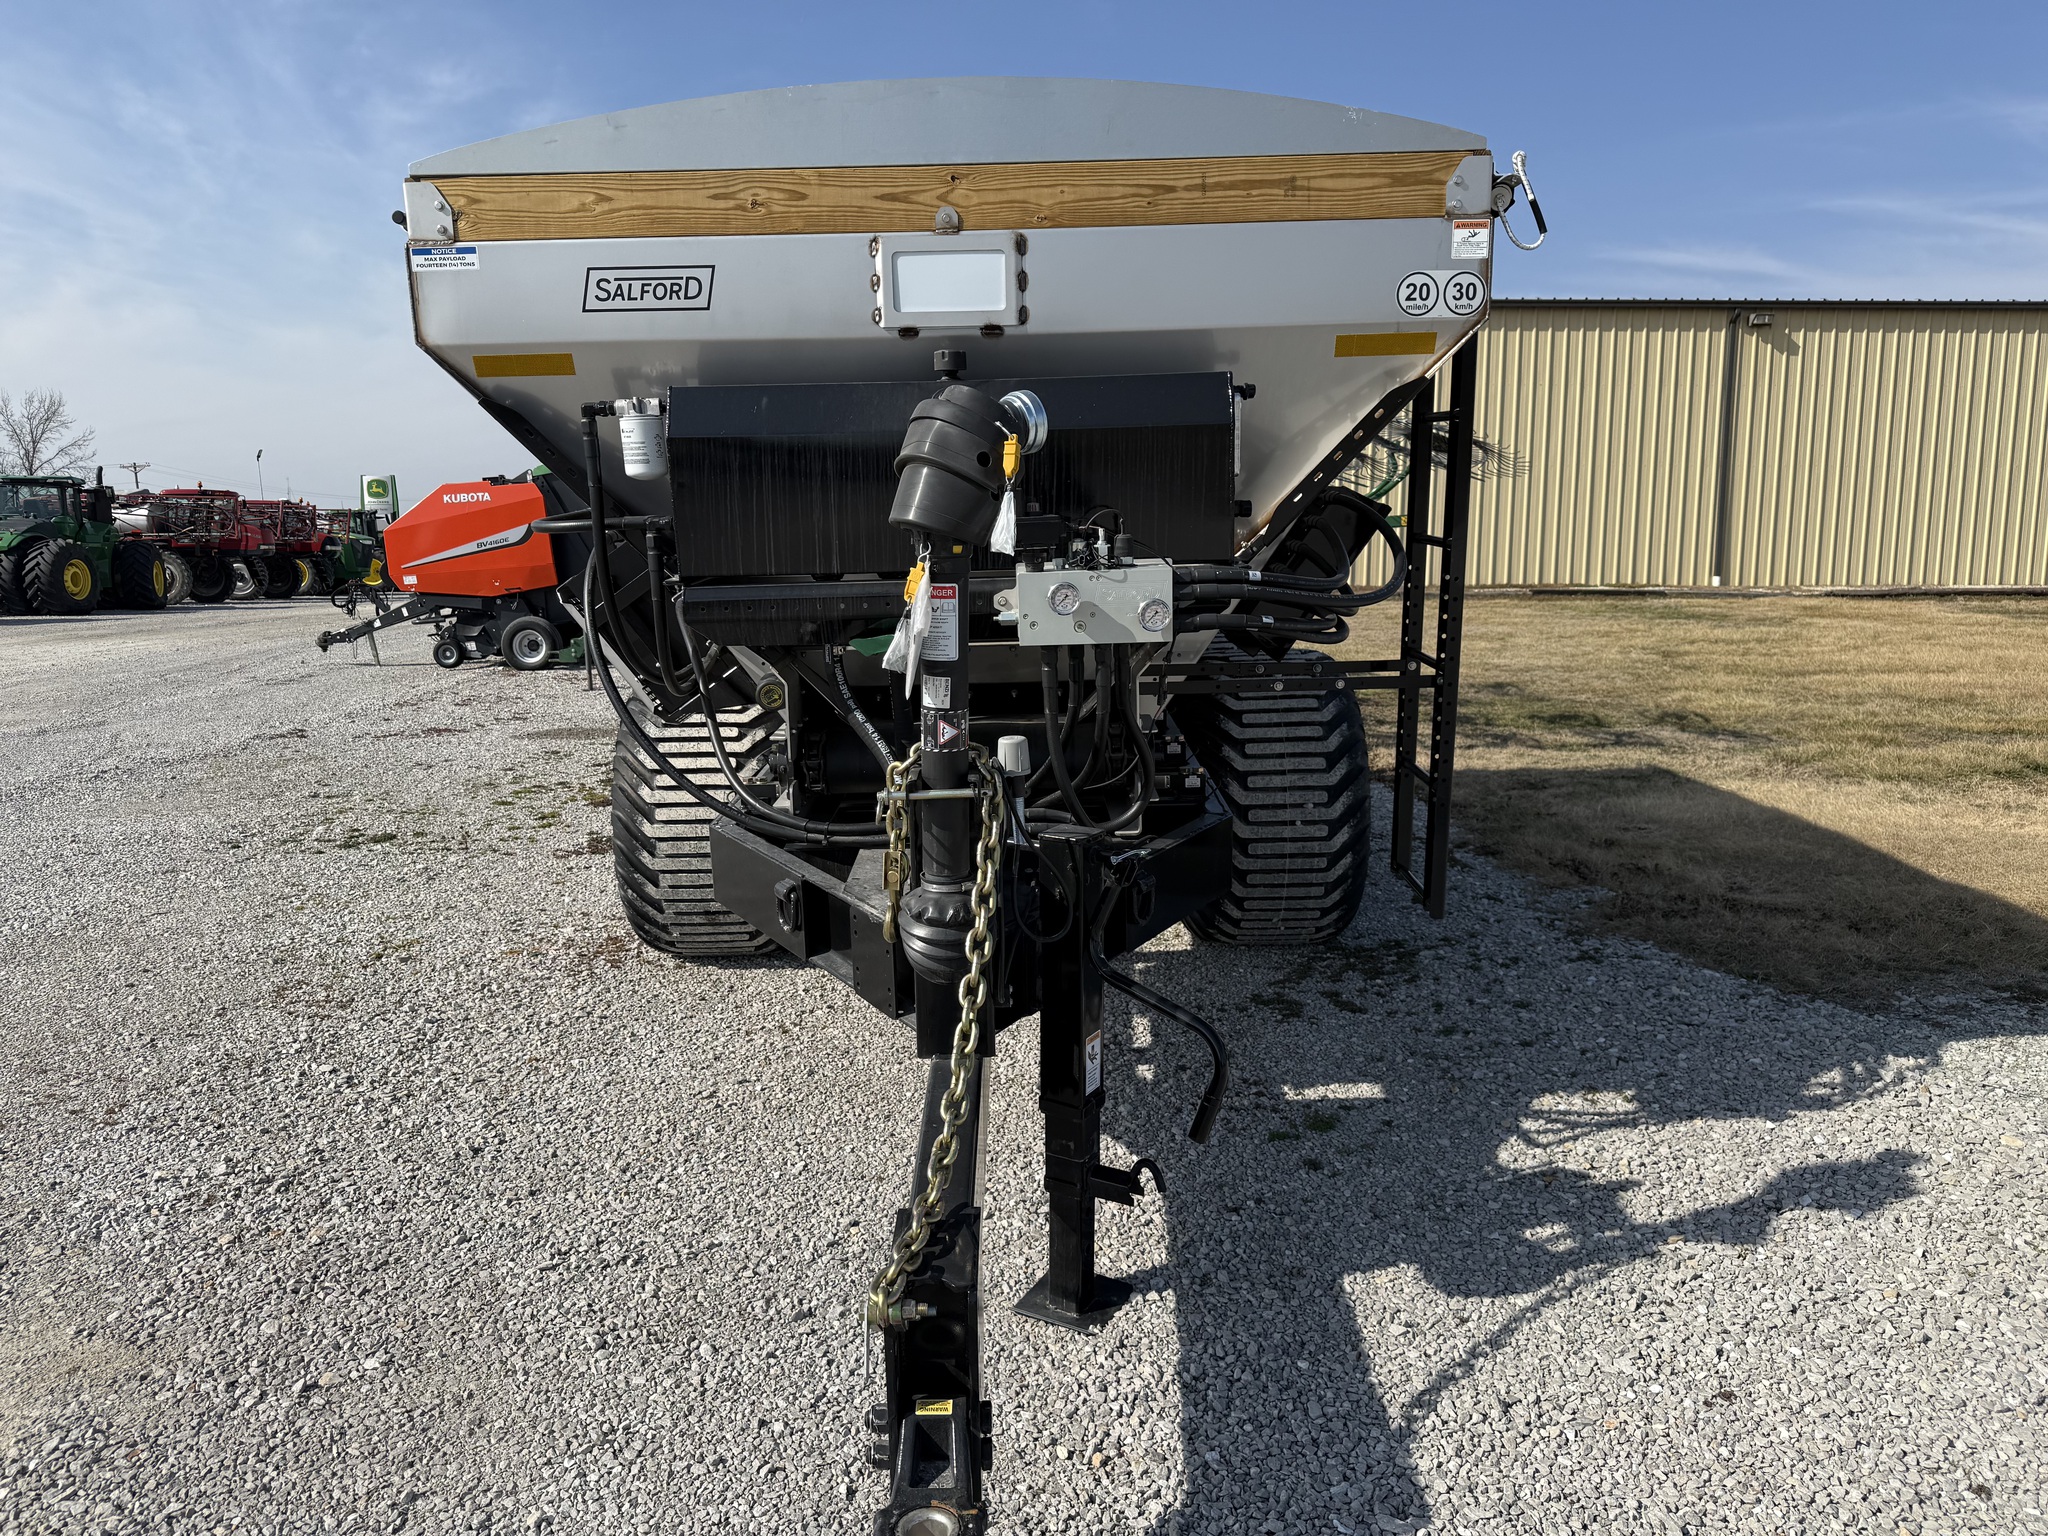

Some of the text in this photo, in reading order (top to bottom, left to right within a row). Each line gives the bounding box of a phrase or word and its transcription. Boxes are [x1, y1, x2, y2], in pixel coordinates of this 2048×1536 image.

[594, 276, 703, 302] SALFORD
[1405, 282, 1431, 302] 20
[1452, 282, 1477, 301] 30
[1406, 303, 1429, 311] mile/h
[1454, 303, 1473, 311] km/h
[443, 492, 491, 504] KUBOTA
[930, 589, 953, 597] NGER
